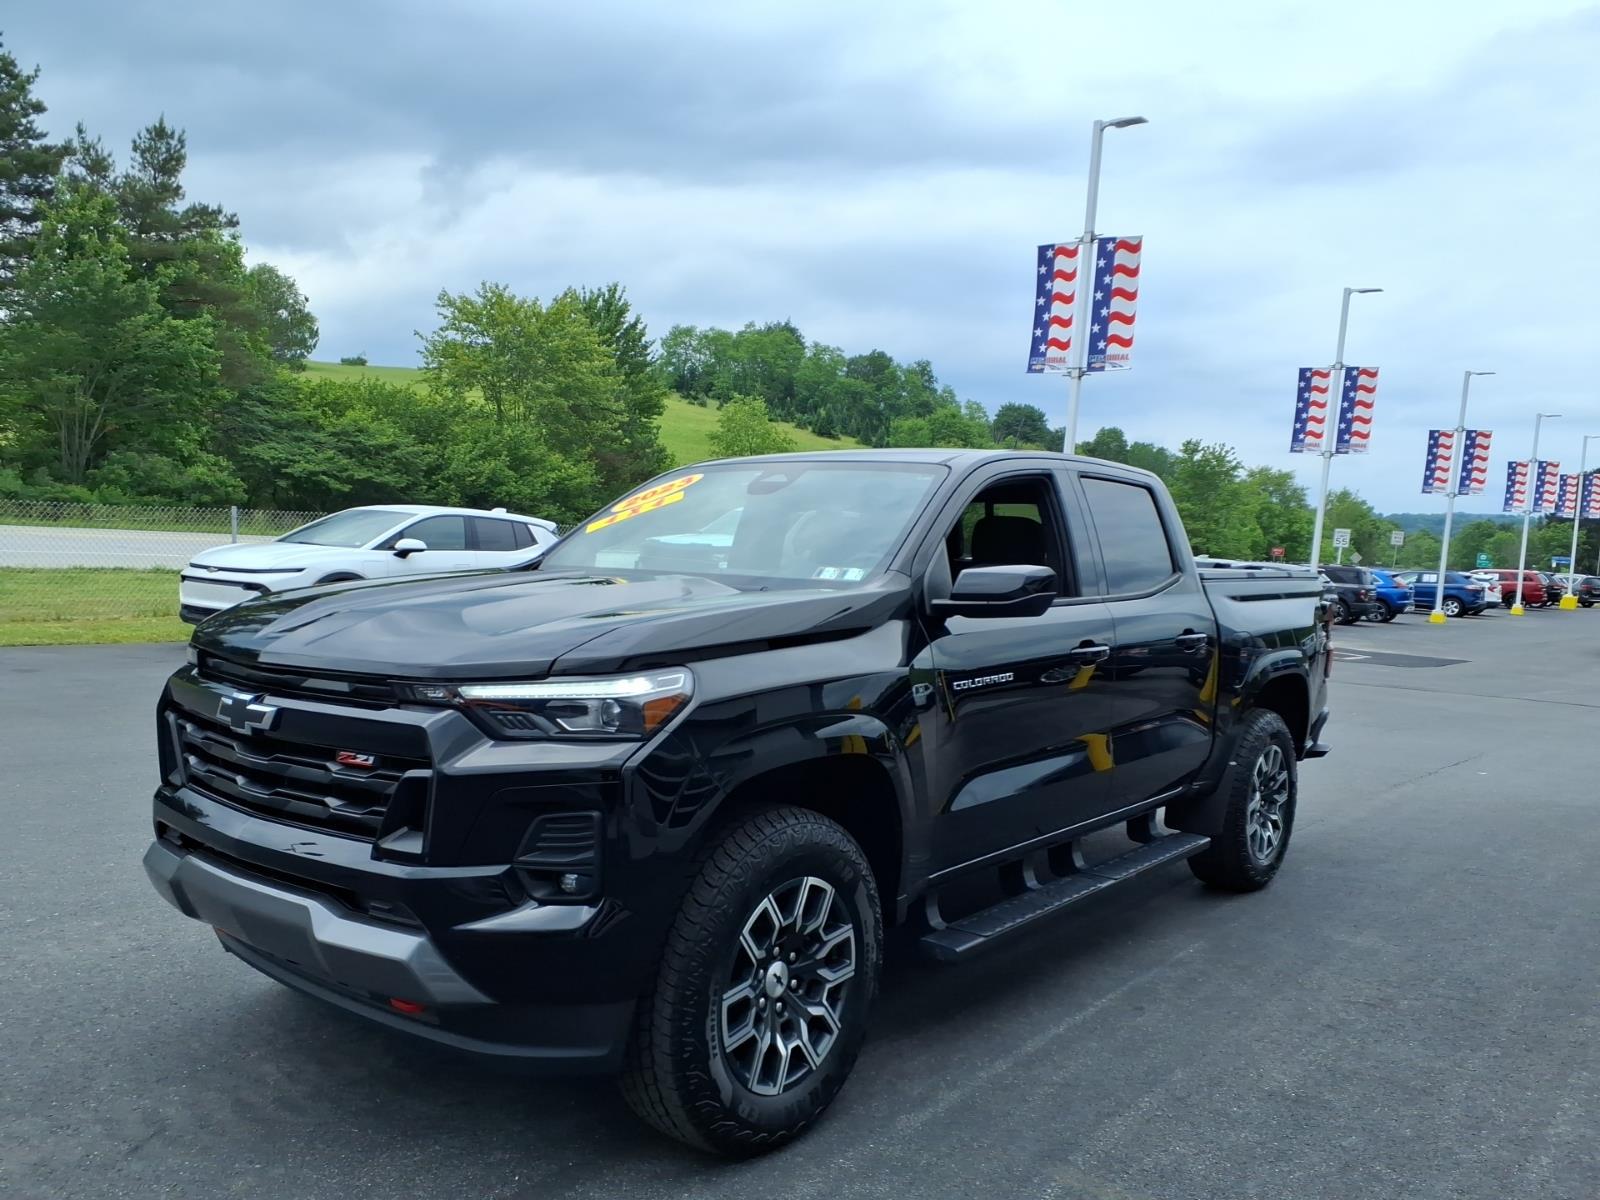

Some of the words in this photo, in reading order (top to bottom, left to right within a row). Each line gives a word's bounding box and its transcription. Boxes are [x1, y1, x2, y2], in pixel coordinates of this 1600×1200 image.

[1336, 537, 1348, 546] 55
[953, 672, 1014, 690] COLORADO
[337, 751, 375, 767] Z71
